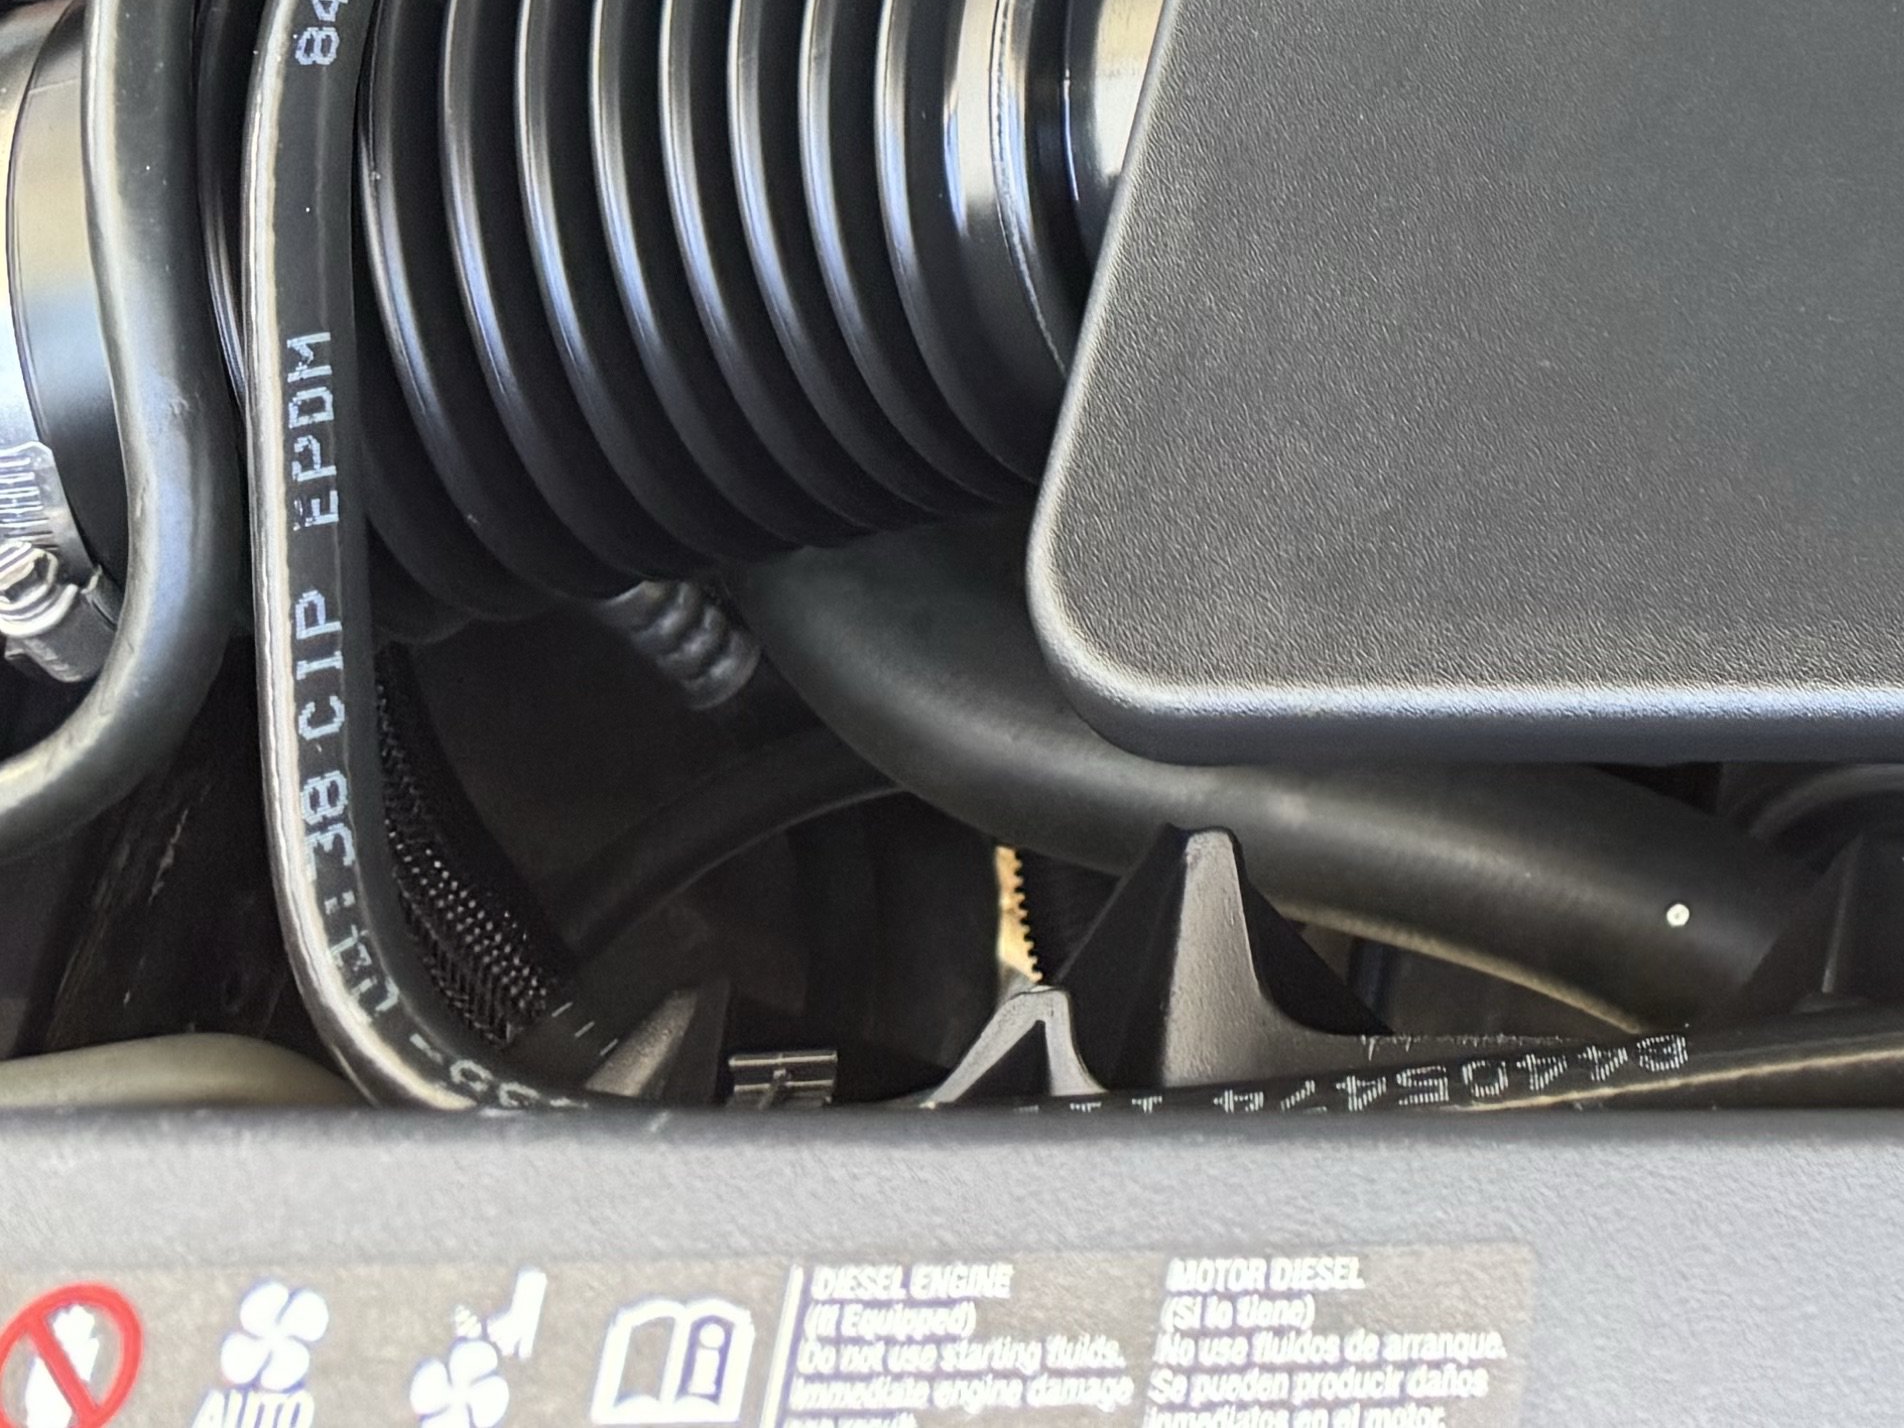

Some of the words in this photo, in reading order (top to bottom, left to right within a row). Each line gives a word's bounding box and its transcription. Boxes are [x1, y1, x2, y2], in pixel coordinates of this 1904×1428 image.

[286, 330, 341, 531] EPDM
[296, 589, 346, 742] CIP
[1212, 1033, 1689, 1113] 84405474
[810, 1263, 907, 1300] DIESEL
[909, 1262, 1014, 1299] ENGINE
[1165, 1257, 1268, 1292] MOTOR
[1269, 1256, 1366, 1290] DIESEL
[840, 1301, 977, 1340] Equipped)
[799, 1339, 837, 1373] Do
[839, 1341, 886, 1373] not
[887, 1343, 938, 1373] use
[939, 1336, 1043, 1376] starting
[1152, 1332, 1196, 1365] No
[1199, 1334, 1249, 1366] use
[1251, 1330, 1341, 1364] fluidos
[1344, 1328, 1381, 1360] de
[932, 1374, 1024, 1414] engine
[1026, 1373, 1135, 1413] damage
[1147, 1367, 1188, 1404] Se
[1190, 1367, 1290, 1407] pueden
[1292, 1364, 1405, 1405] producir
[1406, 1363, 1489, 1397] daños
